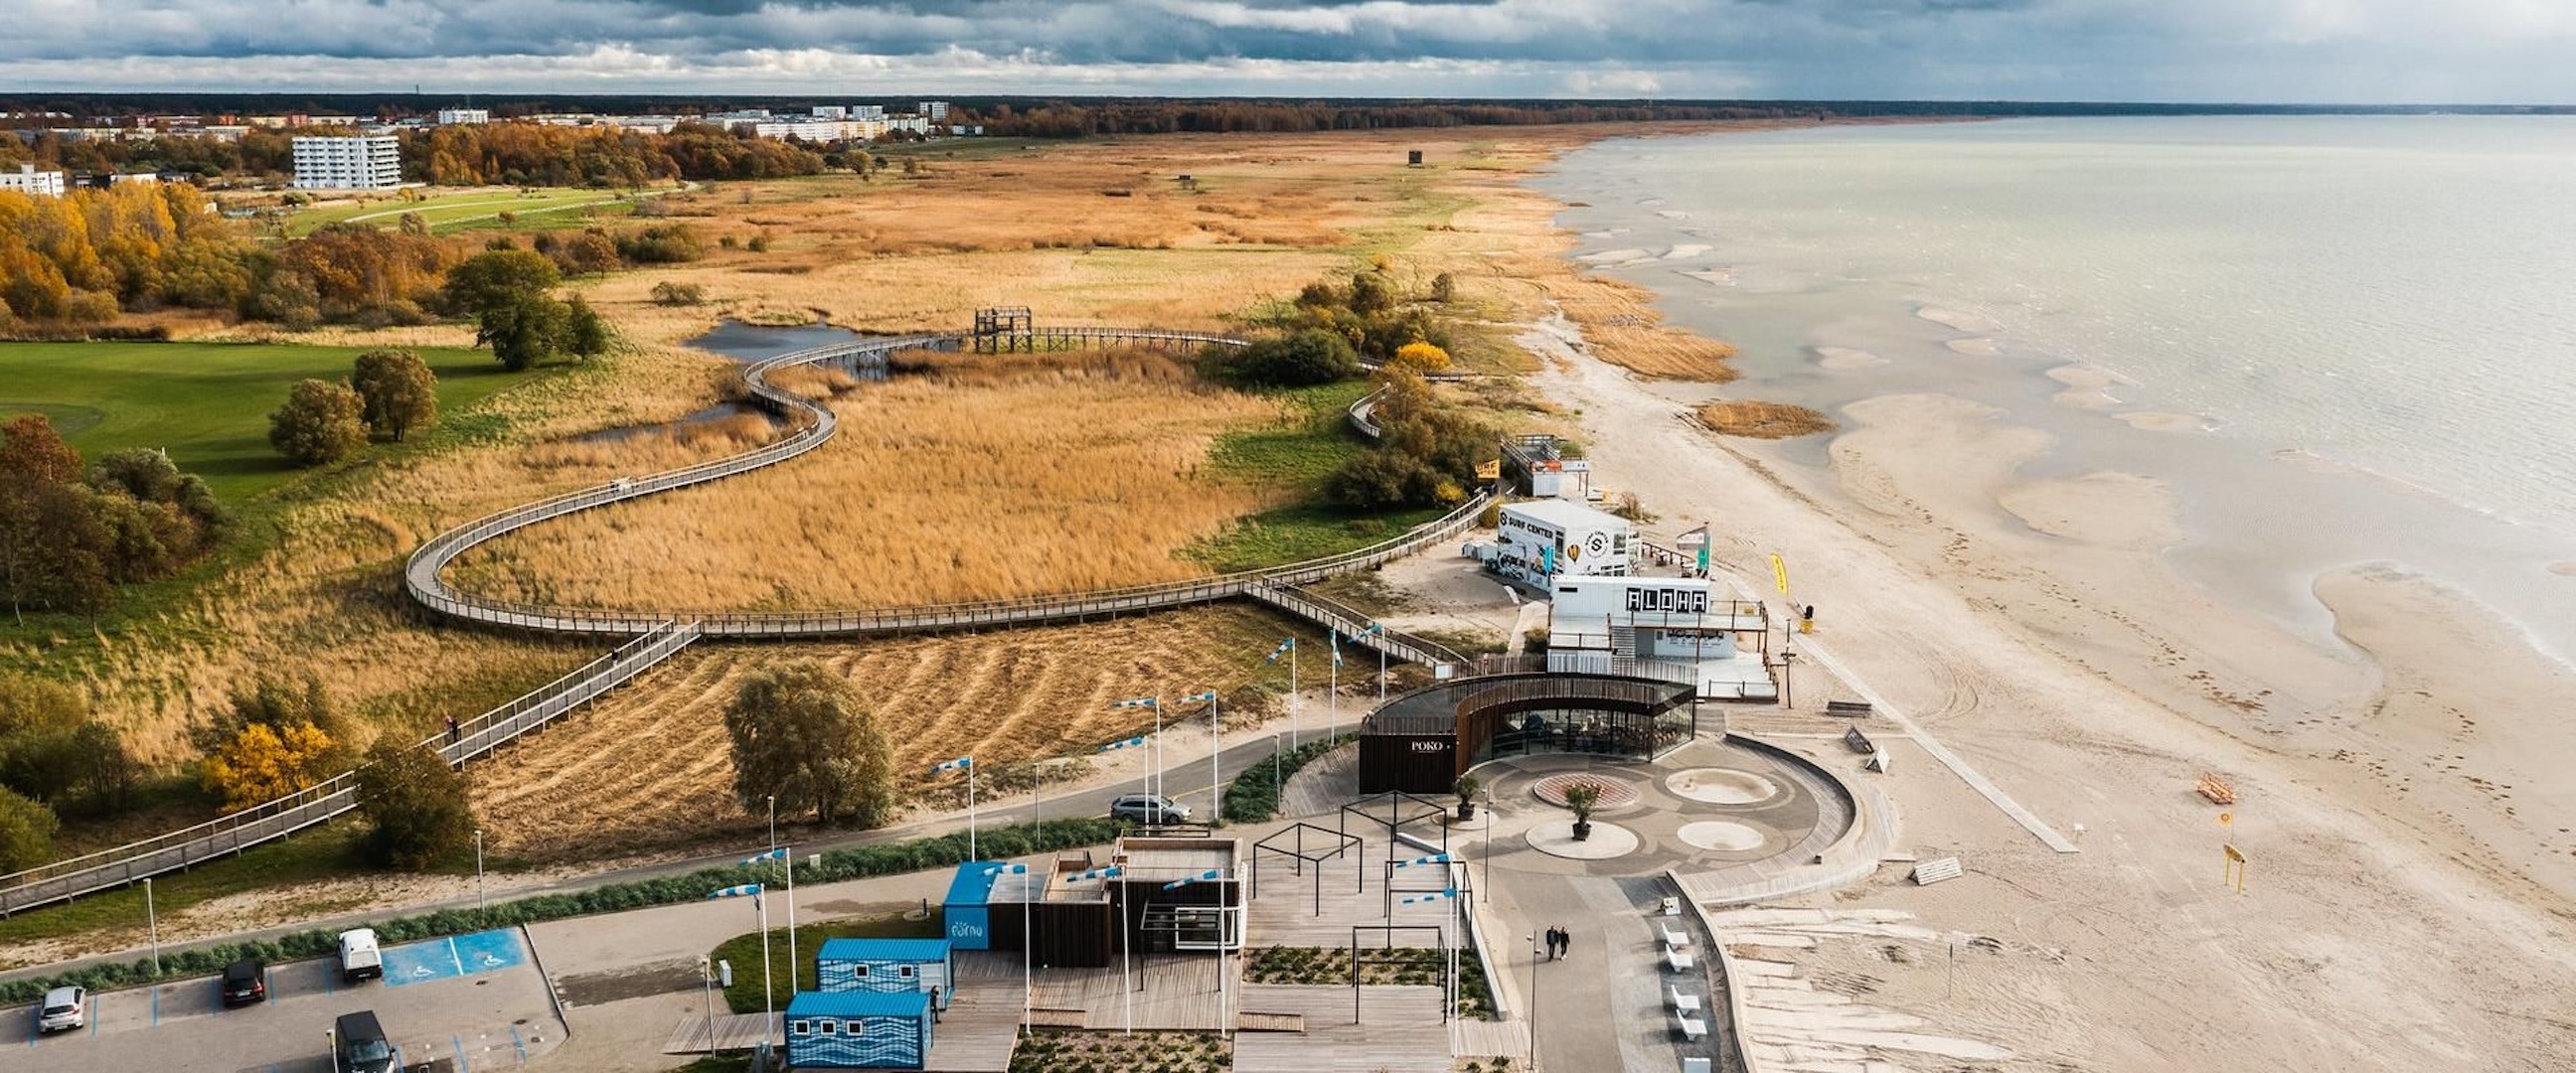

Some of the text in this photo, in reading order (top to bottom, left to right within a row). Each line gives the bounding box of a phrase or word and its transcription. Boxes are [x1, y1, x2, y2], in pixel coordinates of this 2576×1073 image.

[1509, 517, 1526, 530] SURF
[1527, 524, 1553, 538] CENTER
[1627, 588, 1707, 612] ALOHA
[1411, 740, 1443, 751] POKO
